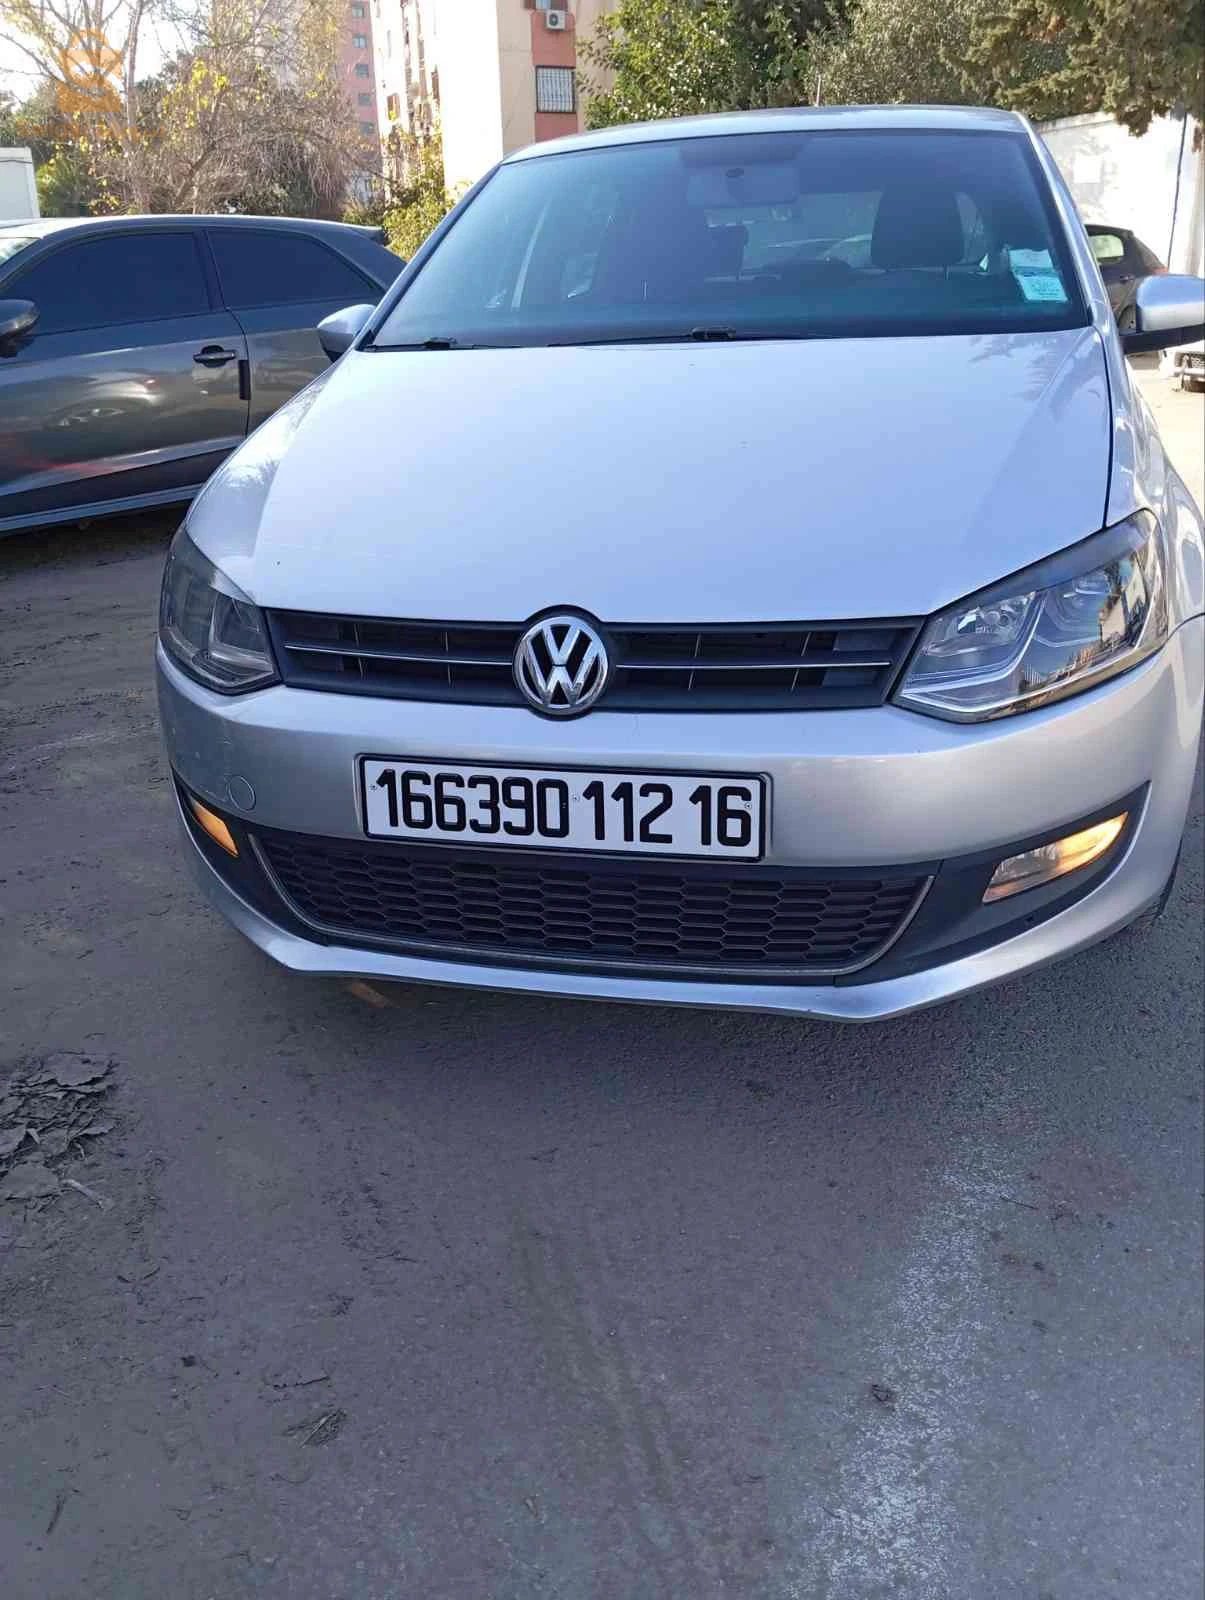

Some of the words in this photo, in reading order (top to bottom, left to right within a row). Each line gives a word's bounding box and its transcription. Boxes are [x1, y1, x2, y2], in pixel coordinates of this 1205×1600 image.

[515, 616, 608, 713] VW
[376, 769, 570, 838] 166390
[582, 780, 673, 844] 112
[689, 784, 752, 848] 16
